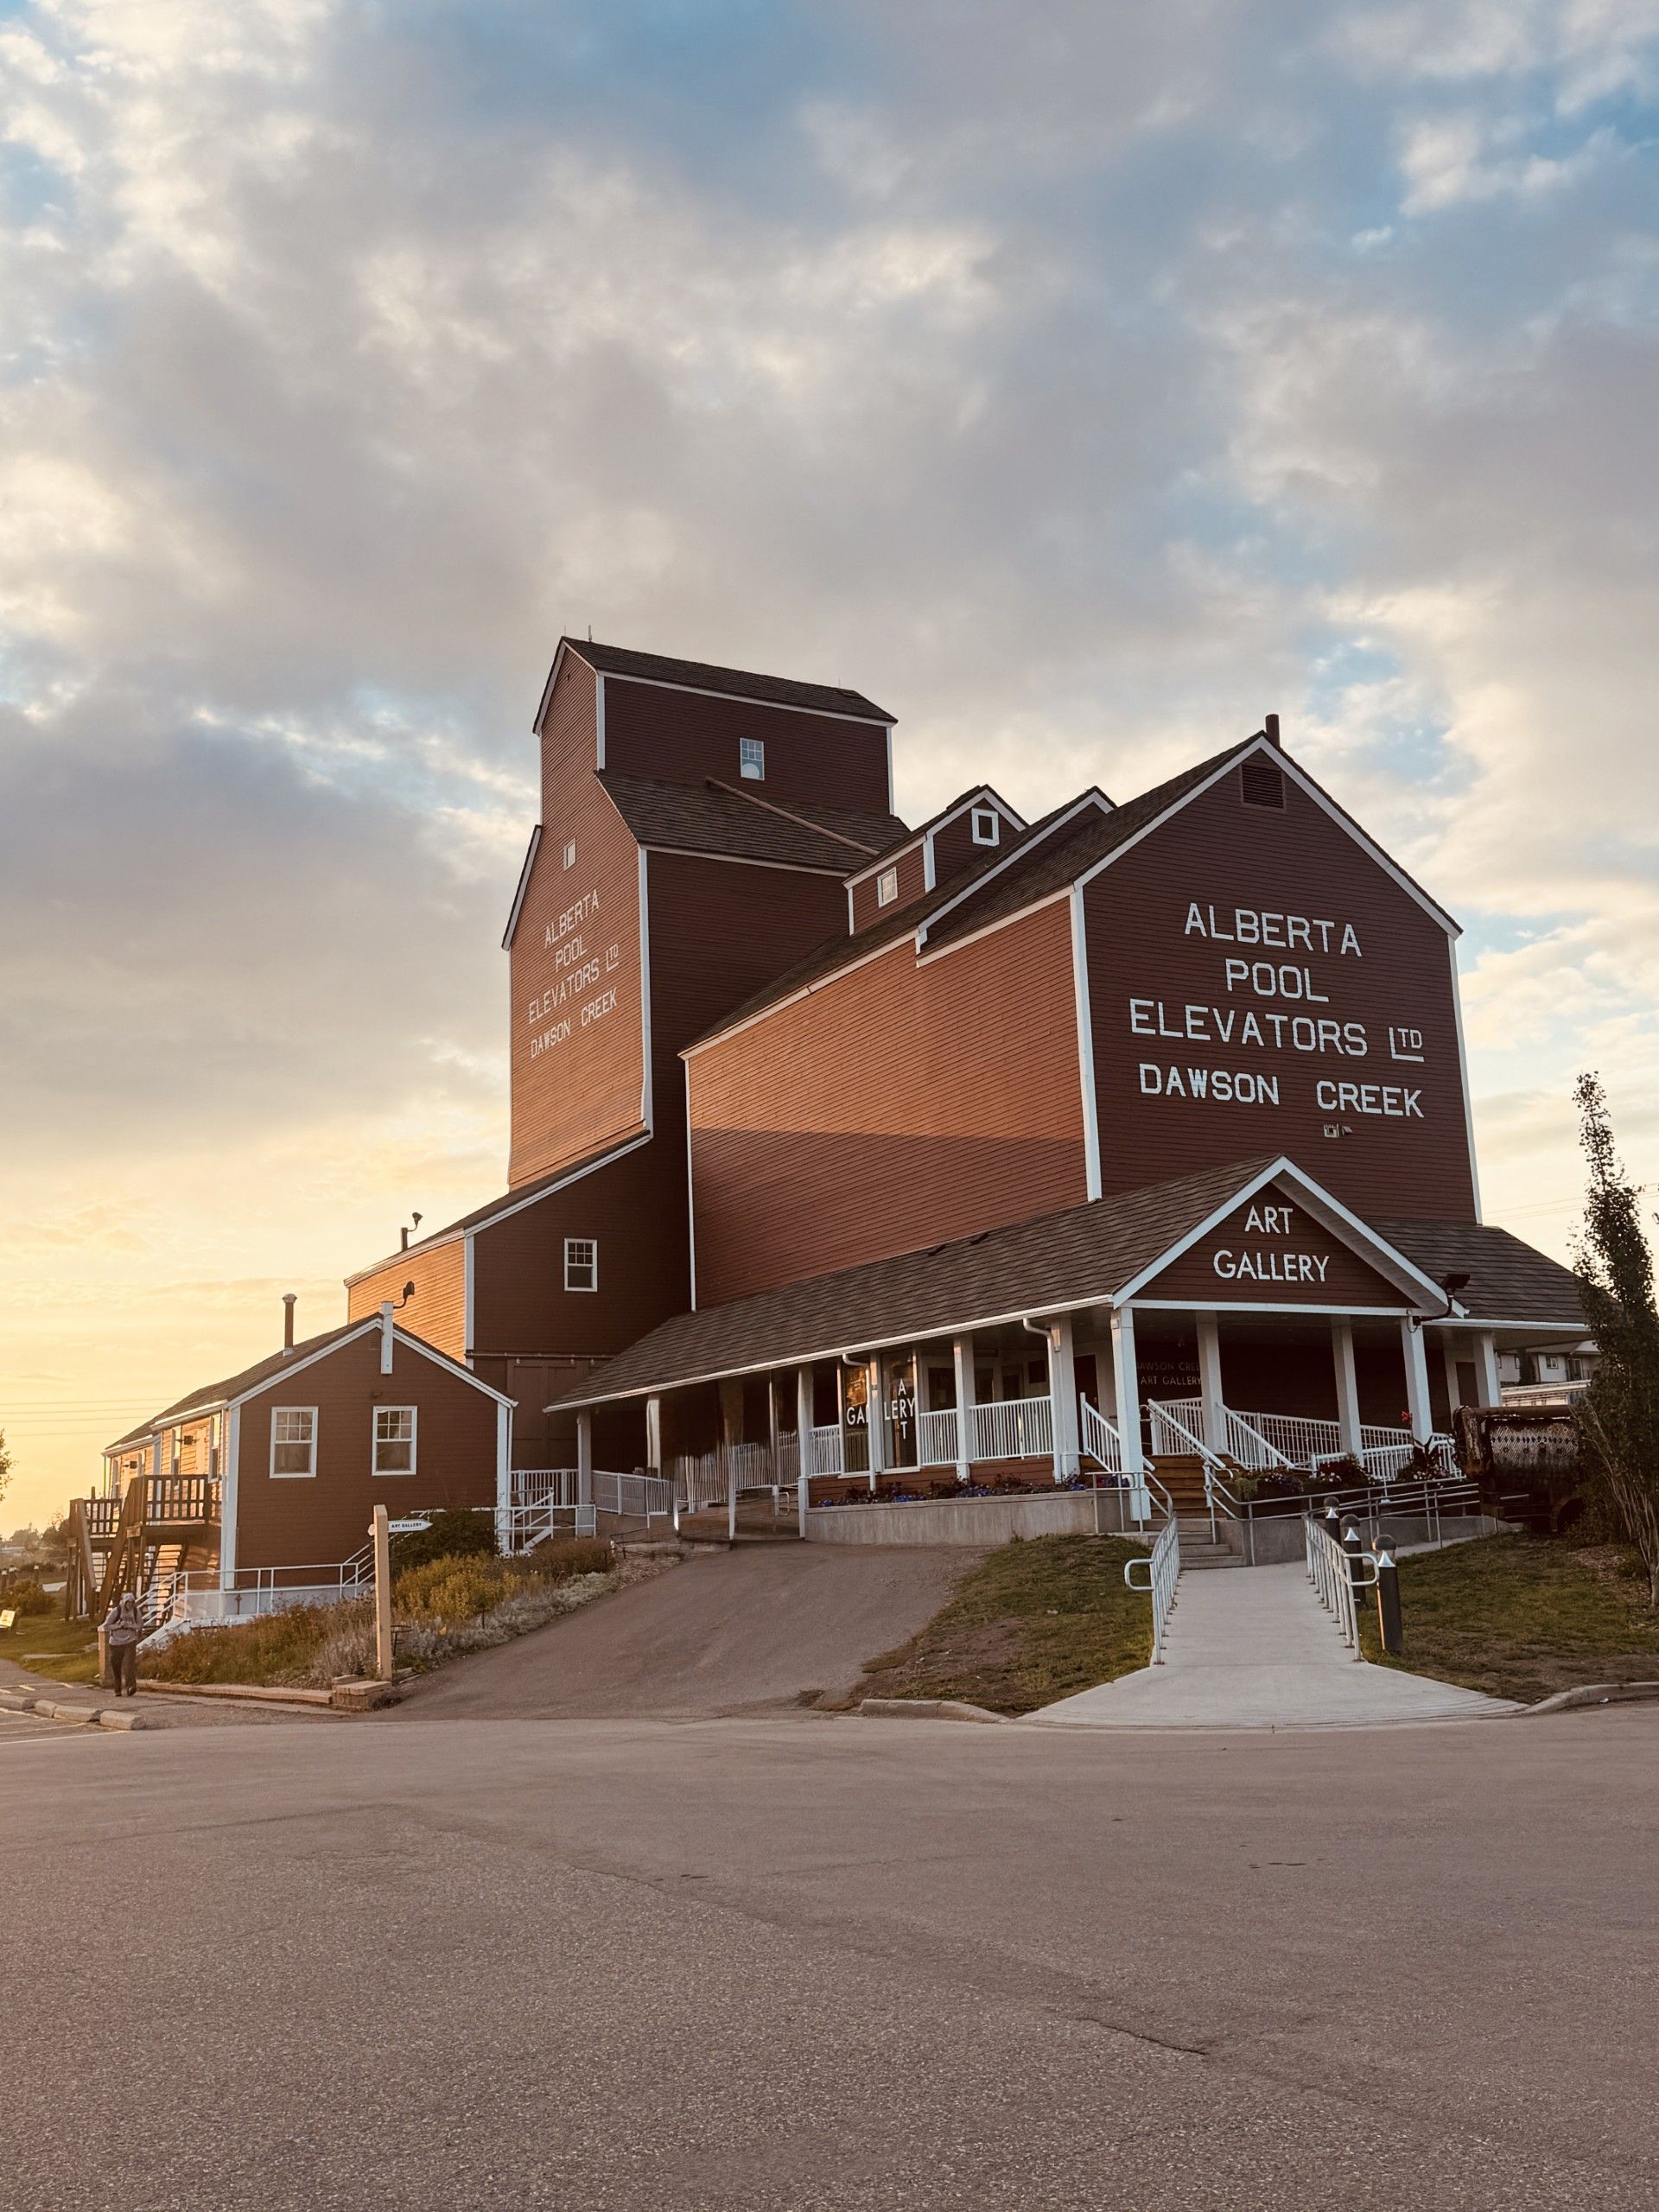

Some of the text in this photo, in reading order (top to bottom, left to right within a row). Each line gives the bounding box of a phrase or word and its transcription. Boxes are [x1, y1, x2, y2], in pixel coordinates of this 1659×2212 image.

[544, 889, 600, 949] ALBERTA
[1184, 902, 1363, 957] ALBERTA
[555, 935, 588, 973] POOL
[1225, 958, 1329, 1002] POOL
[529, 958, 600, 1025] ELEVATORS
[531, 987, 619, 1059] DAWSON CREEK
[1129, 998, 1425, 1063] ELEVATORS LTD
[1139, 1063, 1424, 1118] DAWSON CREEK
[1244, 1205, 1294, 1235] ART
[1213, 1249, 1330, 1283] GALLERY
[1141, 1376, 1157, 1385] ART
